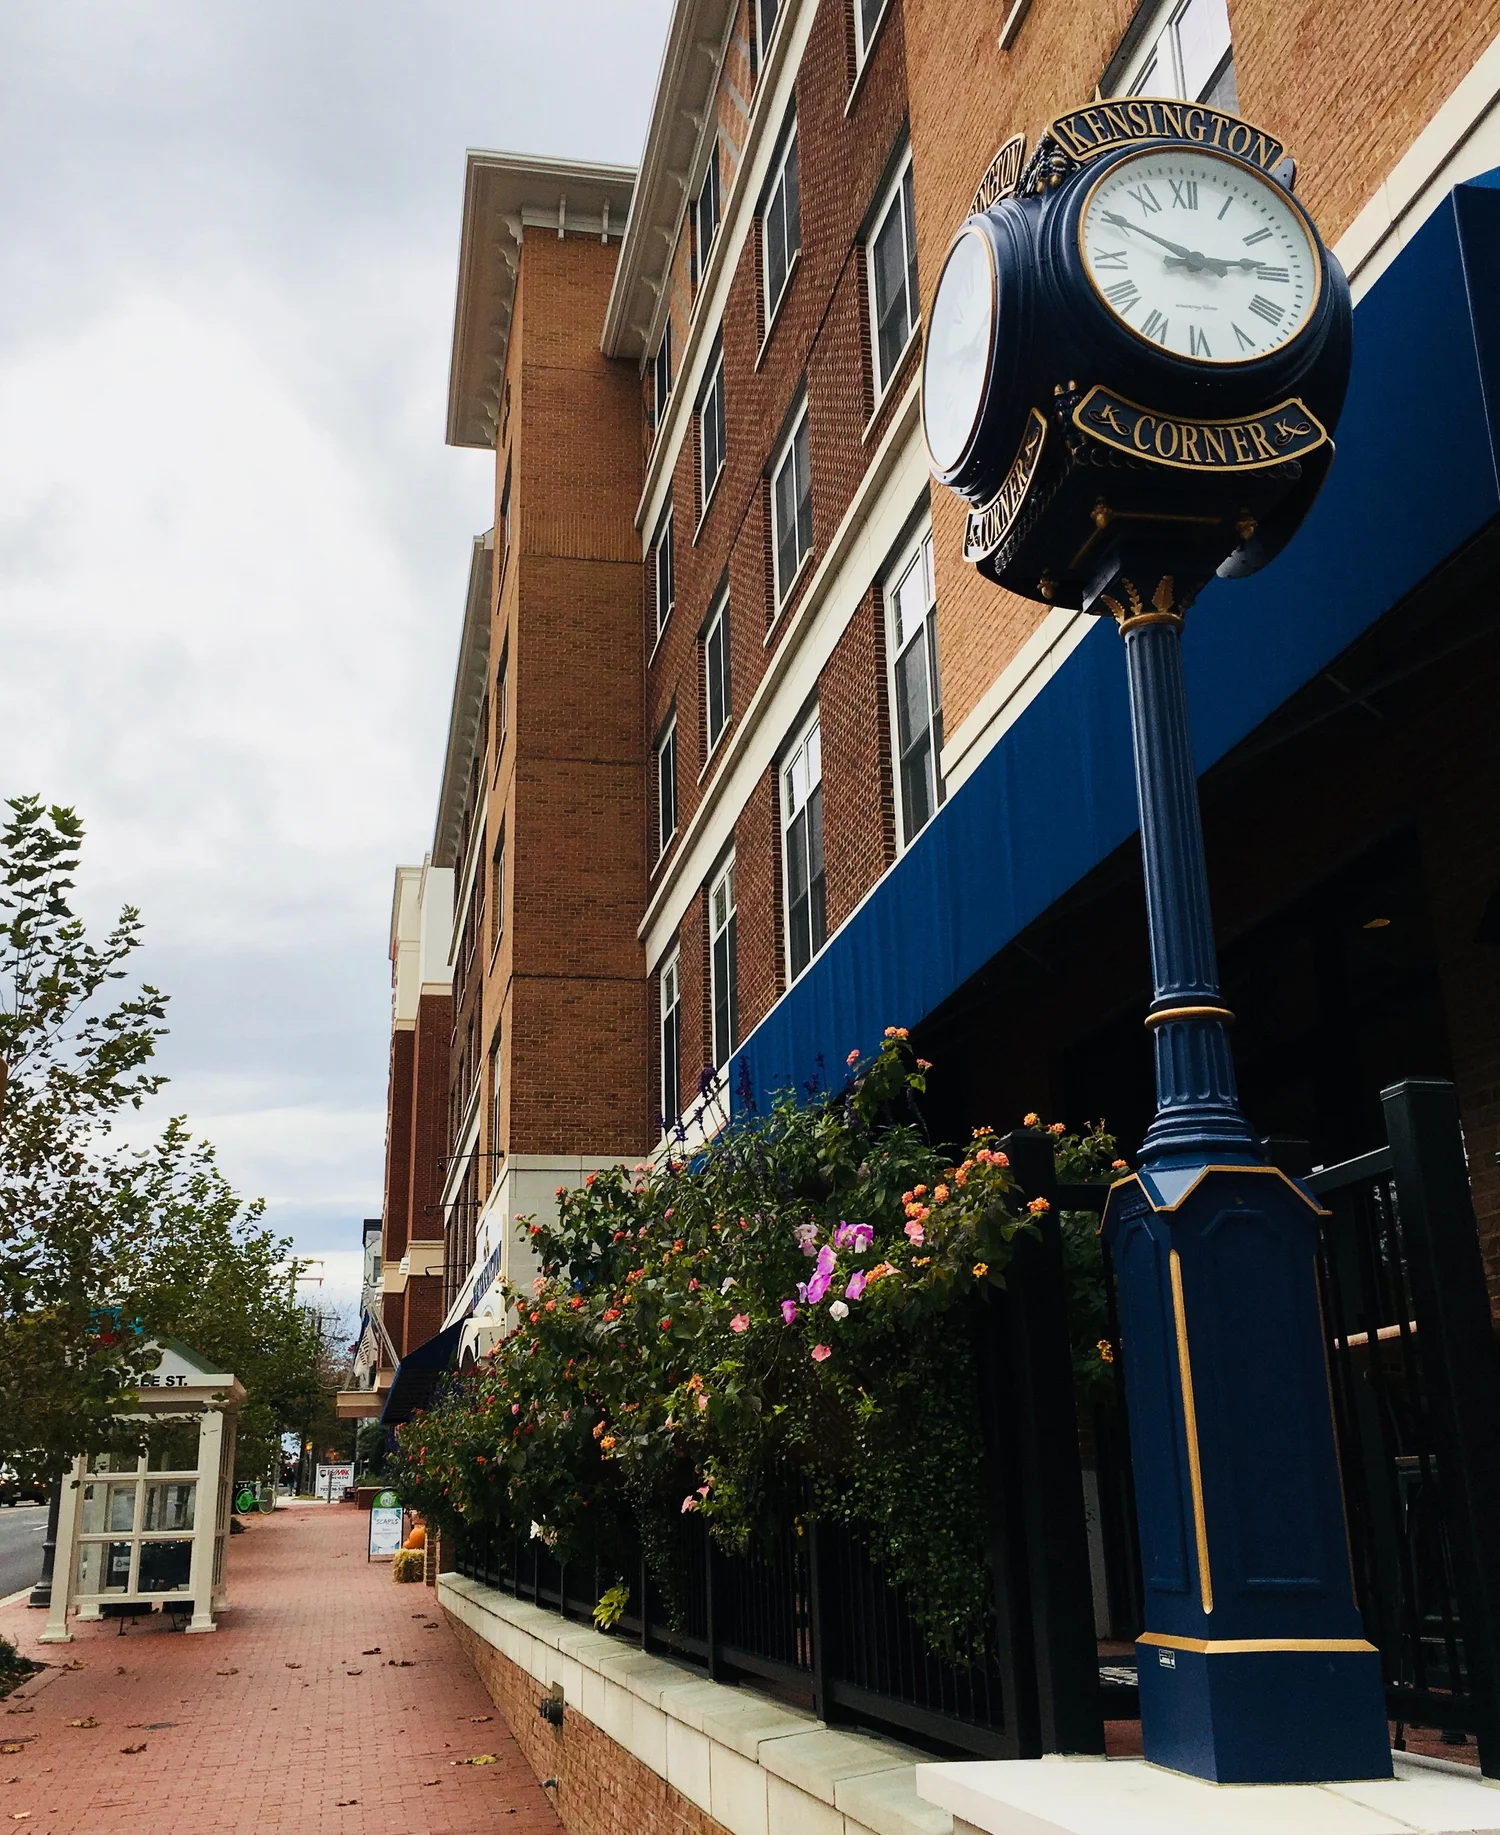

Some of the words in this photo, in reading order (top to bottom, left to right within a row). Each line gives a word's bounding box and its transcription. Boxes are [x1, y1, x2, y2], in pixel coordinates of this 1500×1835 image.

[1057, 102, 1279, 171] KENSINGTON
[970, 140, 1022, 214] INGTON
[1127, 182, 1162, 217] XI
[1168, 179, 1199, 211] XII
[1217, 195, 1234, 221] I
[1242, 227, 1273, 247] II
[1094, 247, 1129, 270] IX
[1256, 266, 1291, 283] III
[1102, 279, 1142, 316] VIII
[1248, 294, 1286, 327] IIII
[1140, 308, 1169, 345] VII
[1189, 324, 1212, 358] VI
[1231, 321, 1256, 352] V
[1133, 415, 1279, 464] CORNER
[980, 458, 1029, 549] CORNER
[165, 1375, 188, 1387] ST.
